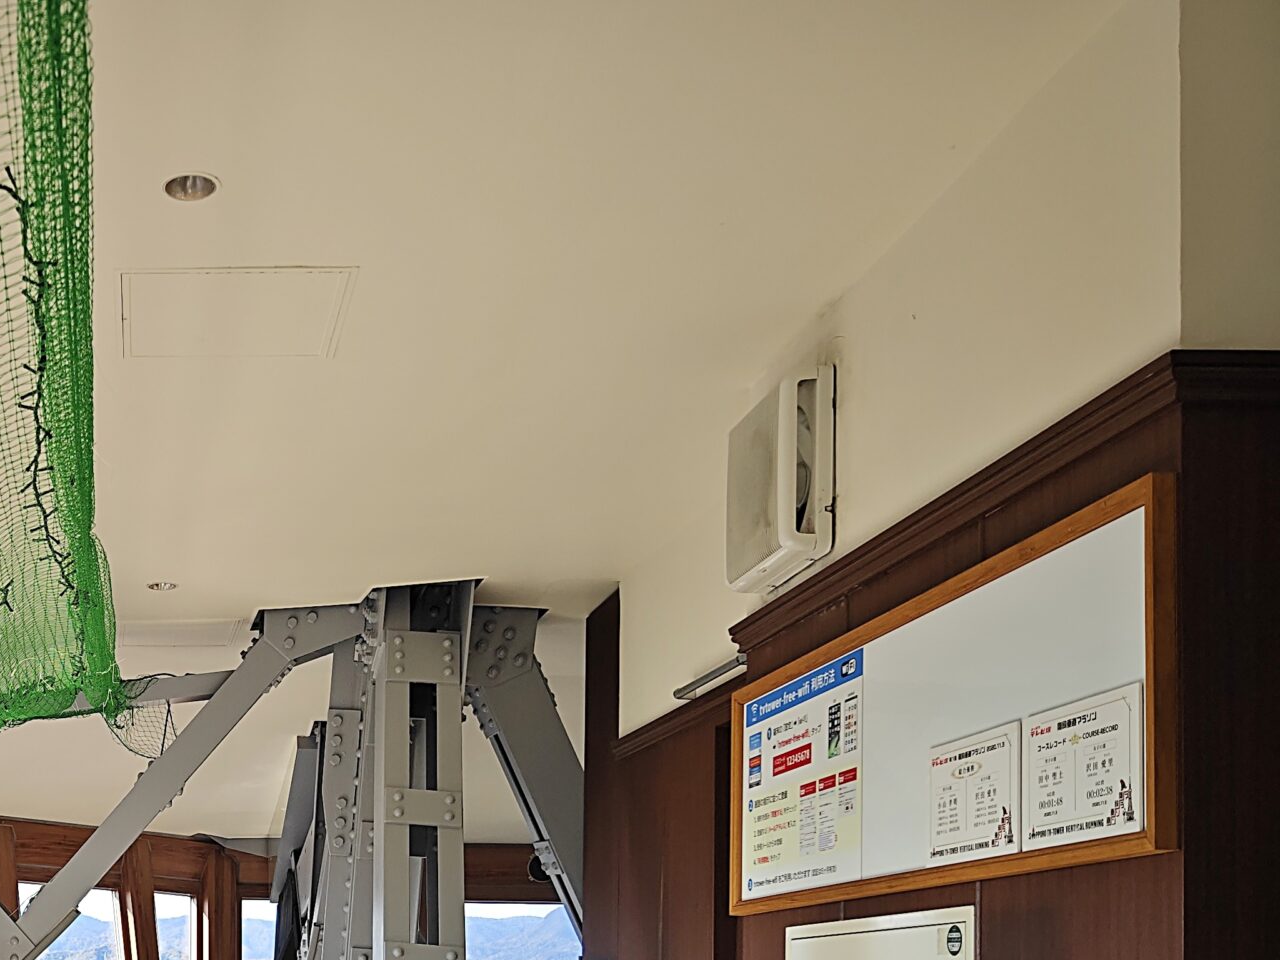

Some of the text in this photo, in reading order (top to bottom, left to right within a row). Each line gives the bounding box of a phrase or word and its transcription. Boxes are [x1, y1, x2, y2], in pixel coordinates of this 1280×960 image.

[1037, 738, 1067, 752] コースレコード
[1086, 785, 1113, 799] 00:02:38
